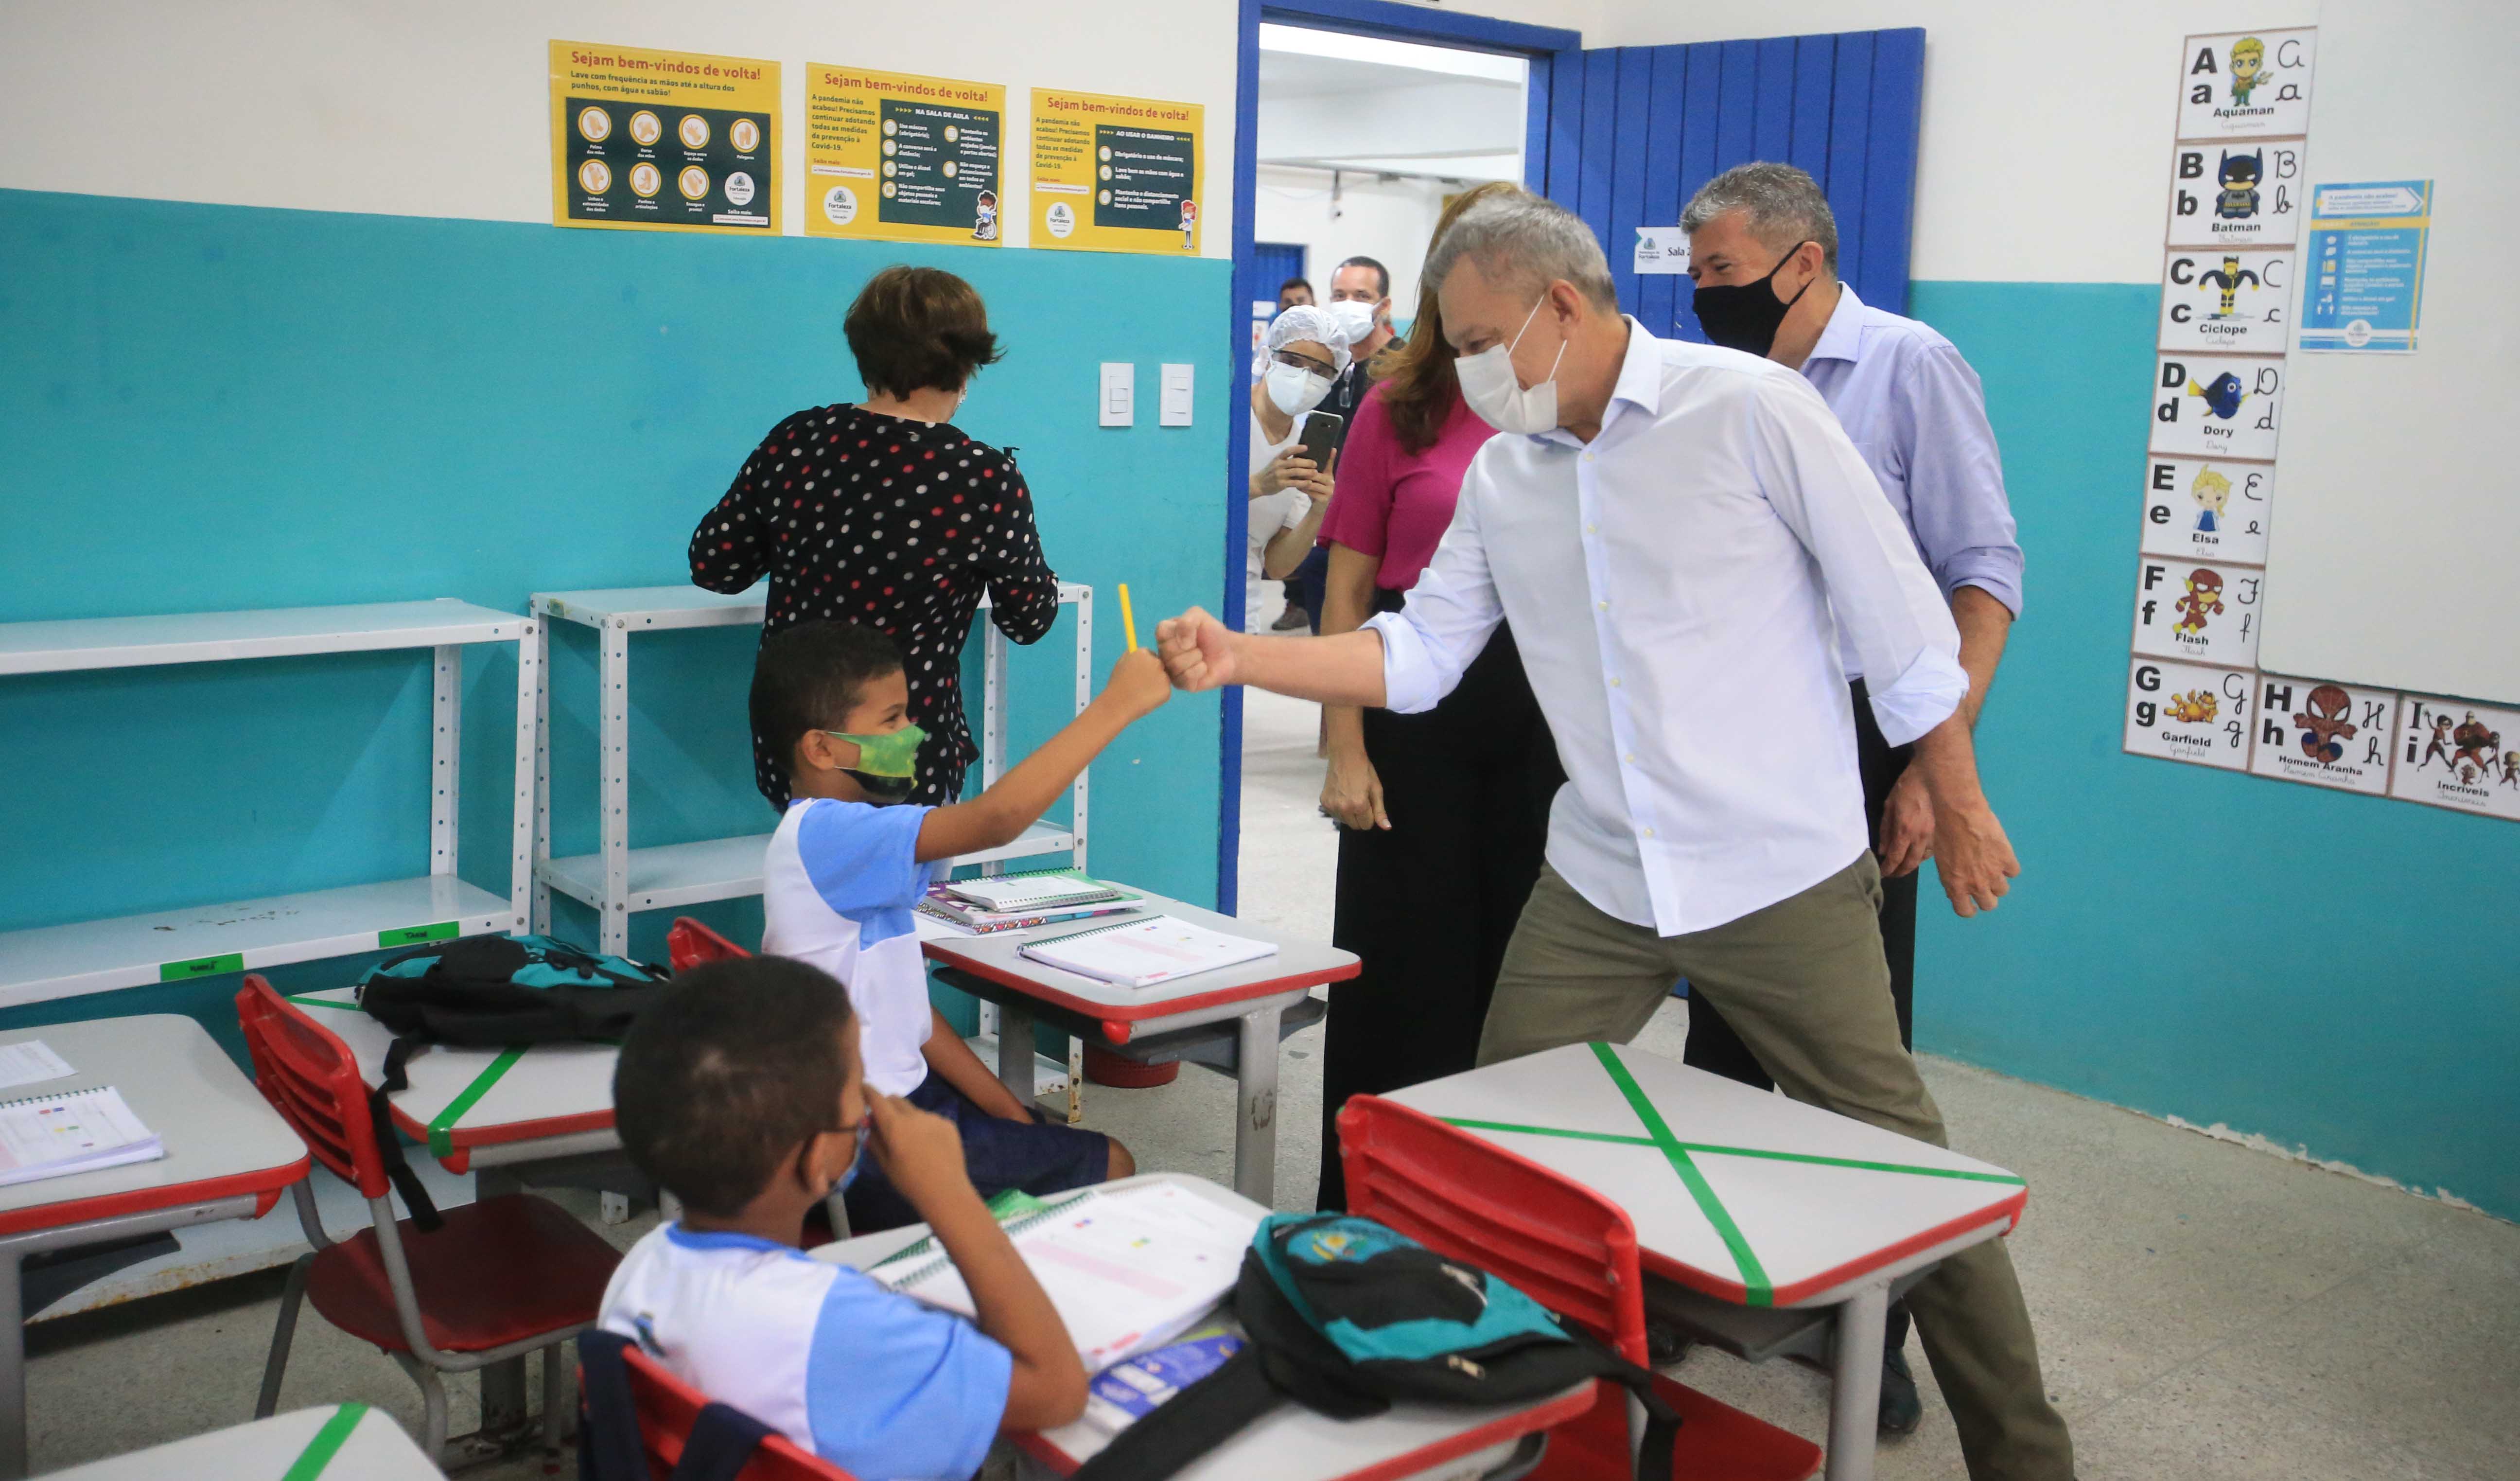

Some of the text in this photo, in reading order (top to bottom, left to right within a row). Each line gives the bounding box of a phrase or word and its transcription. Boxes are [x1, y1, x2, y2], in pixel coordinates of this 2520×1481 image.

[572, 51, 760, 79] Sejam bem-vindos de volta!
[2191, 48, 2218, 74] A
[572, 82, 601, 91] punhos,
[621, 86, 639, 94] água
[609, 74, 648, 84] frequência
[825, 73, 987, 102] Sejam bem-vindos de volta!
[2191, 84, 2212, 104] a
[2275, 84, 2302, 101] a
[840, 106, 875, 115] Precisamos
[1048, 98, 1189, 120] Sejam bem-vindos de volta!
[2213, 106, 2275, 118] Aquaman
[812, 142, 842, 151] Covid-19.
[822, 135, 855, 143] prevenção
[2179, 152, 2203, 179] B
[2275, 151, 2296, 178] B
[2177, 190, 2198, 215] b
[2272, 185, 2293, 214] b
[2212, 223, 2261, 232] Batman
[1668, 247, 1684, 256] Sala
[2170, 258, 2194, 285] C
[2264, 260, 2283, 287] C
[2170, 303, 2191, 323] c
[2264, 309, 2280, 322] c
[2200, 324, 2247, 335] Ciclope
[2162, 362, 2186, 388] D
[2254, 368, 2278, 395] D
[2158, 397, 2179, 422] d
[2255, 402, 2274, 430] d
[2204, 426, 2233, 438] Dory
[2206, 441, 2227, 454] Dory
[2152, 464, 2175, 491] E
[2245, 473, 2263, 501] E
[2150, 505, 2170, 524] e
[2245, 520, 2261, 534] e
[2192, 533, 2219, 544] Elsa
[2145, 565, 2165, 590] F
[2238, 579, 2259, 604] F
[2143, 600, 2157, 625] f
[2175, 633, 2209, 645] Flash
[2240, 613, 2251, 643] f
[2135, 666, 2161, 691] G
[2223, 673, 2247, 715] G
[2265, 684, 2292, 712] H
[2136, 701, 2156, 727] g
[2362, 701, 2384, 730] H
[2409, 701, 2424, 729] I
[2162, 732, 2211, 747] Garfield
[2223, 721, 2243, 748] g
[2263, 719, 2284, 746] h
[2363, 737, 2384, 766] h
[2407, 736, 2417, 763] i
[2279, 756, 2362, 776] Homem Aranha
